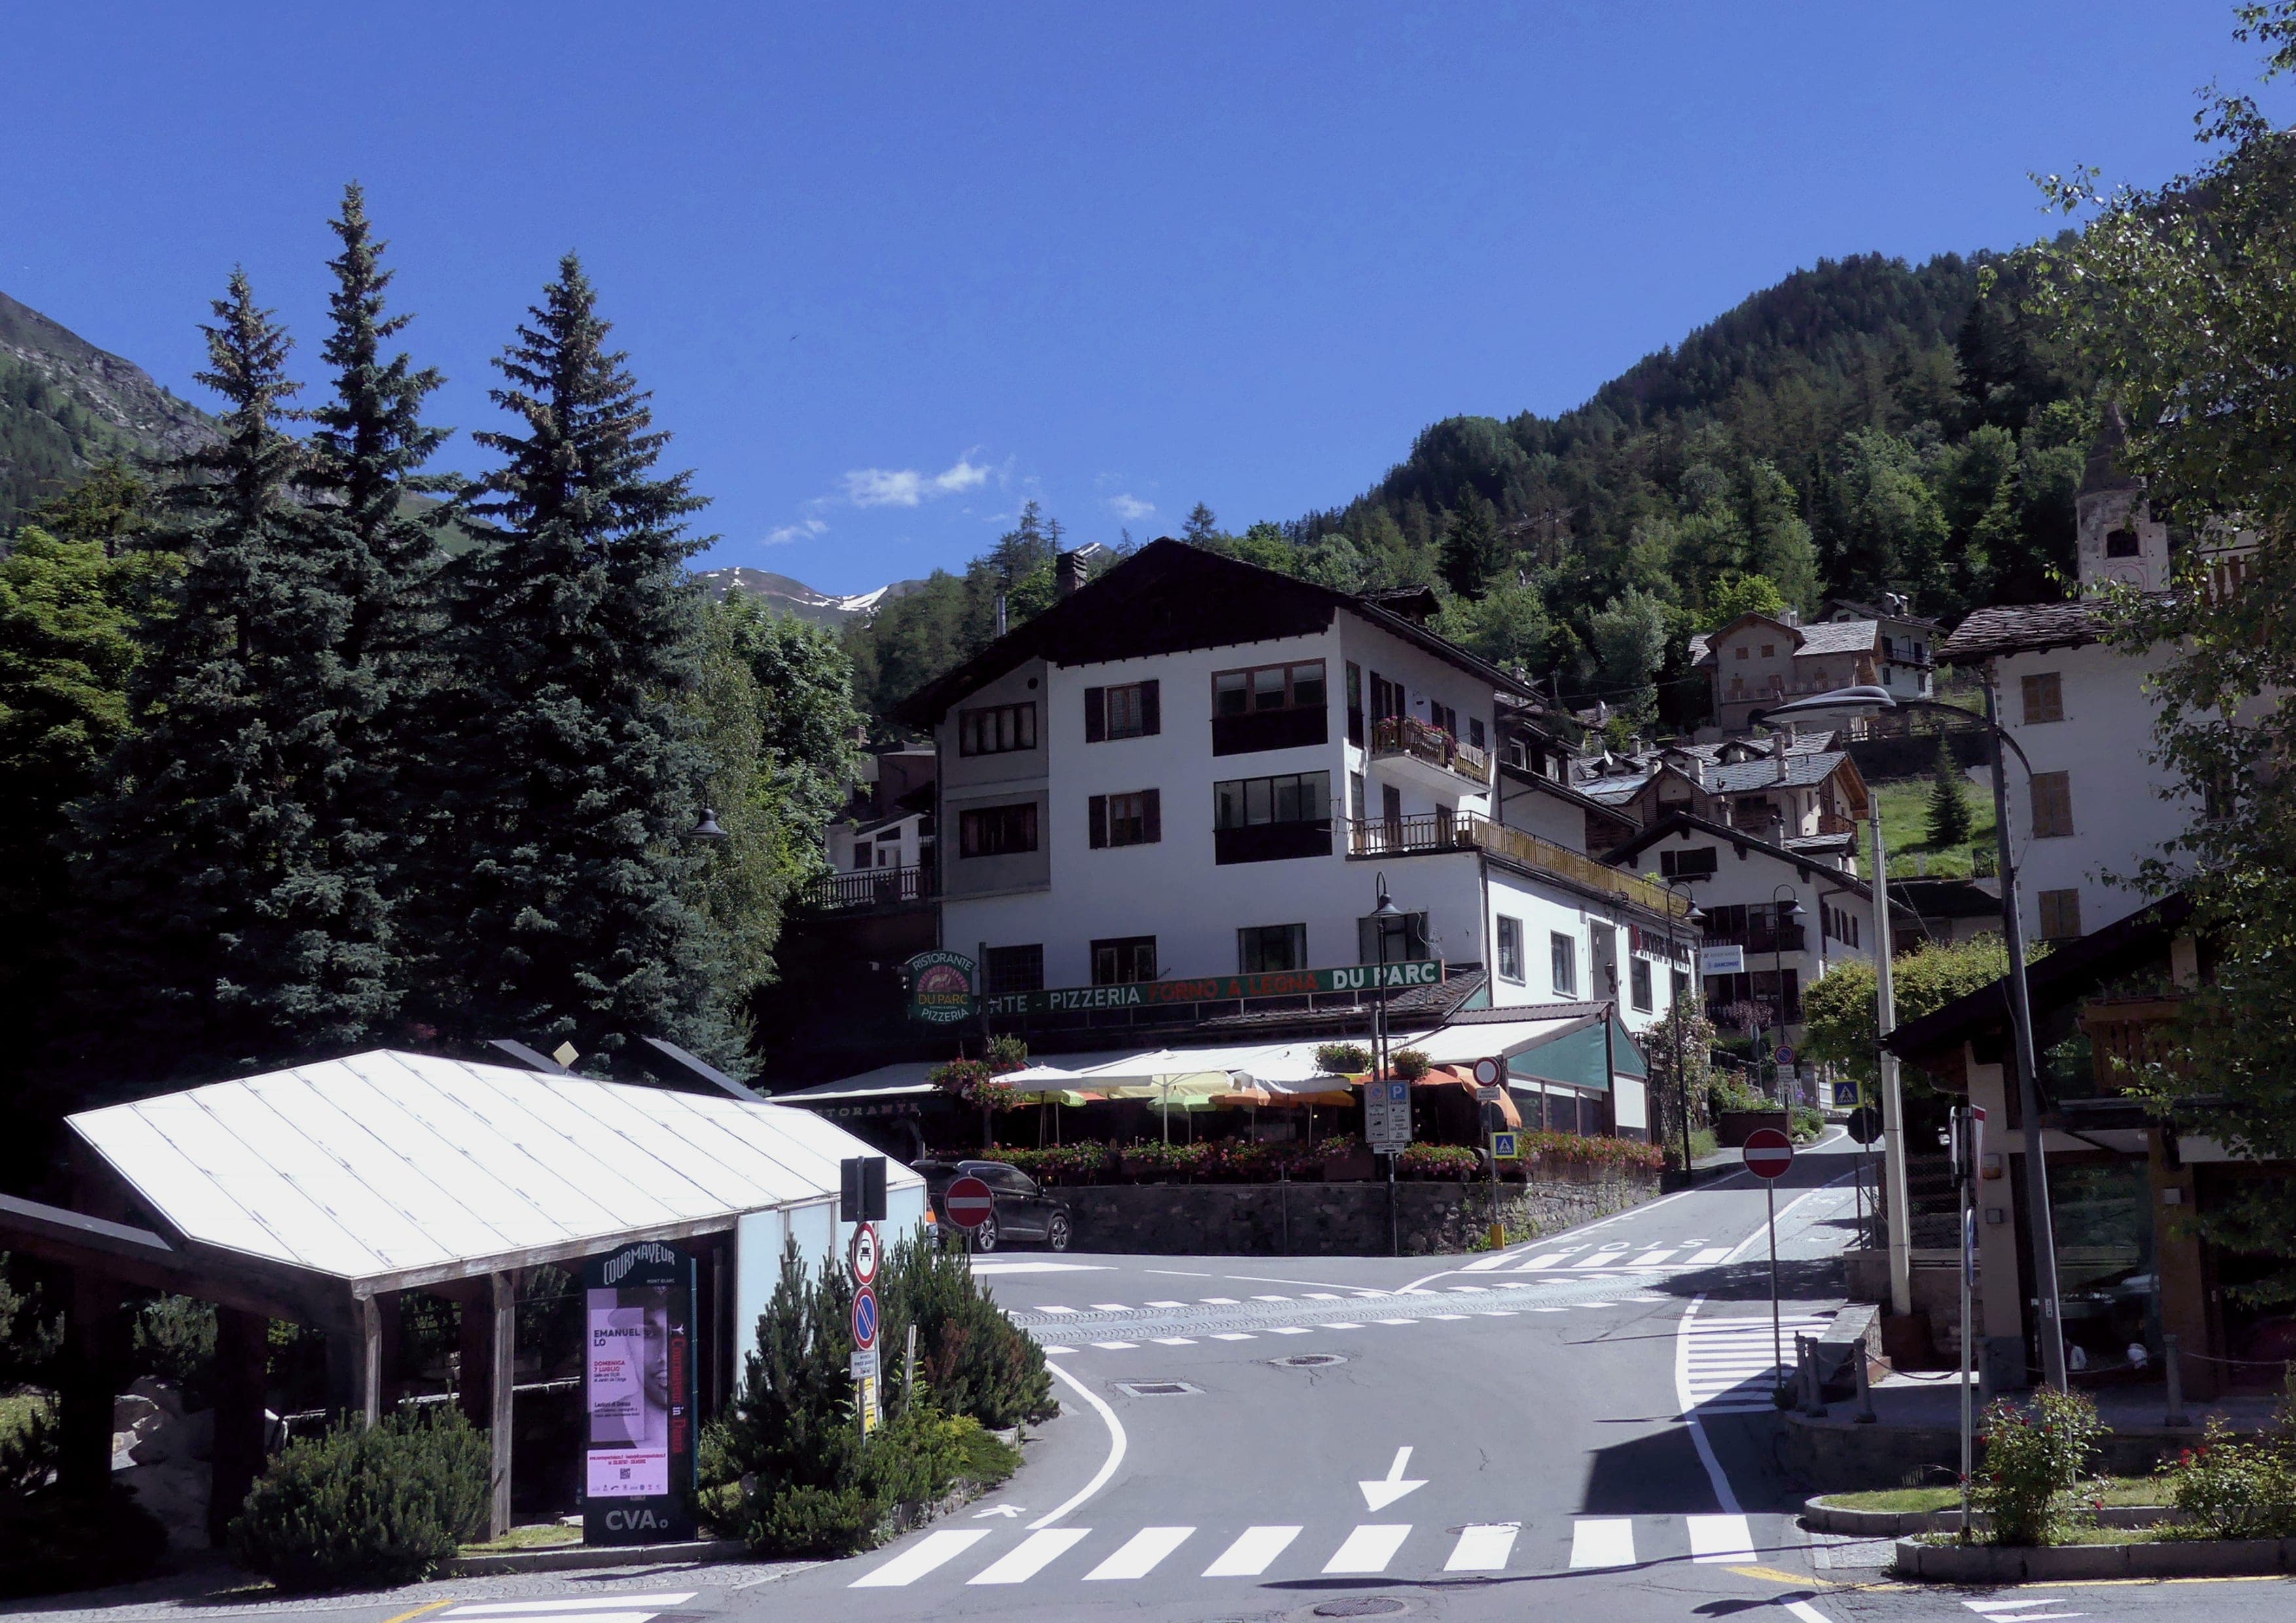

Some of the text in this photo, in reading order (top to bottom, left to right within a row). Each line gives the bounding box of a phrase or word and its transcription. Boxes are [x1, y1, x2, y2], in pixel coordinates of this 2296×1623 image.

[912, 953, 973, 971] RISTORANTE
[1050, 986, 1140, 1009] PIZZERIA
[1148, 980, 1219, 1002] FORNO
[1227, 978, 1242, 997] A
[1249, 973, 1319, 995] LEGNA
[1333, 968, 1364, 990] DU
[1373, 963, 1436, 986] PARC
[918, 994, 968, 1005] DU PARC
[921, 1008, 969, 1022] PIZZERIA
[1392, 1085, 1402, 1098] P
[1559, 1238, 1710, 1253] STOP
[604, 1243, 675, 1285] COURMAYEUR
[594, 1329, 641, 1338] EMANUEL
[594, 1338, 606, 1347] LO
[672, 1406, 685, 1416] in
[605, 1509, 657, 1531] CVA
